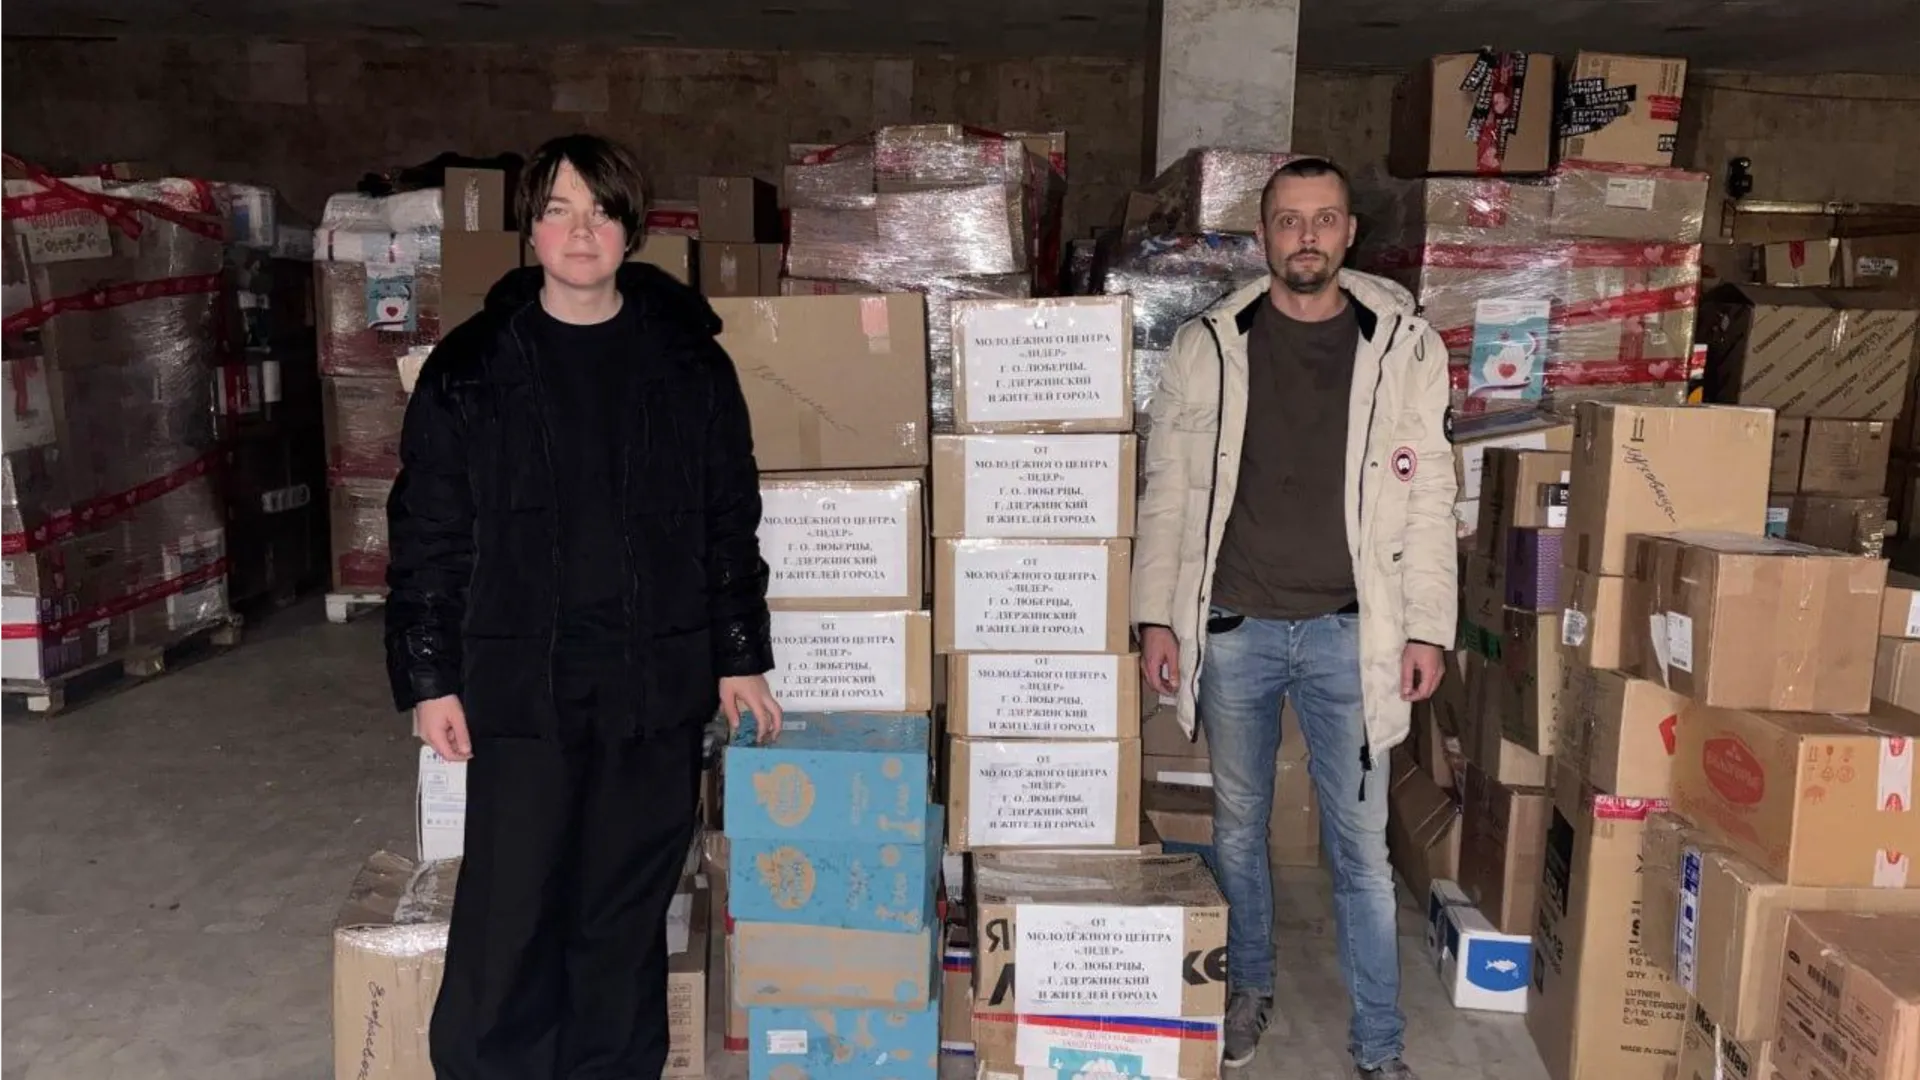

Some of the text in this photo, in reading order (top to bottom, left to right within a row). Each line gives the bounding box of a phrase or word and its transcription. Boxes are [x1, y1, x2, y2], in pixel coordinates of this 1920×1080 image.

[975, 334, 1111, 346] МОЛОДЁЖНОГО ЦЕНТРА
[1008, 377, 1091, 388] ДЗЕРЖИНСКИЙ
[988, 392, 1100, 403] И ЖИТЕЛЕЙ ГОРОДА
[1034, 446, 1048, 454] ОТ
[975, 459, 1108, 469] МОЛОДЁЖНОГО ЦЕНТРА
[823, 502, 837, 511] ОТ
[1007, 500, 1088, 510] ДЗЕРЖИНСКИЙ
[763, 515, 897, 525] МОЛОДЁЖНОГО ЦЕНТРА
[997, 514, 1050, 524] ЖИТЕЛЕЙ
[1054, 516, 1096, 524] ГОРОДА
[796, 556, 877, 565] ДЗЕРЖИНСКИЙ
[787, 569, 840, 580] ЖИТЕЛЕЙ
[843, 571, 885, 580] ГОРОДА
[965, 569, 1097, 581] МОЛОДЁЖНОГО ЦЕНТРА
[998, 611, 1076, 620] ДЗЕРЖИНСКИЙ
[822, 622, 835, 631] ОТ
[987, 625, 1040, 634] ЖИТЕЛЕЙ
[1043, 626, 1084, 634] ГОРОДА
[770, 635, 895, 645] ОЛОДЁЖНОГО ЦЕНТРА
[978, 668, 1107, 680] МОЛОДЁЖНОГО ЦЕНТРА
[796, 675, 876, 684] ДЗЕРЖИНСКИЙ
[776, 688, 883, 698] И ЖИТЕЛЕЙ ГОРОДА
[1008, 708, 1087, 717] ДЗЕРЖИНСКИЙ
[999, 720, 1050, 731] ЖИТЕЛЕЙ
[1053, 723, 1095, 732] ГОРОДА
[1067, 769, 1107, 778] ЦЕНТРА
[999, 820, 1052, 829] ЖИТЕЛЕЙ
[1055, 821, 1095, 829] ГОРОДА
[1091, 917, 1106, 927] ОТ
[1027, 930, 1172, 943] МОЛОДЁЖНОГО ЦЕНТРА
[1061, 975, 1149, 985] ДЗЕРЖИНСКИЙ
[1039, 989, 1158, 1000] И ЖИТЕЛЕЙ ГОРОДА
[1625, 988, 1661, 999] LUTNER
[1620, 1044, 1642, 1053] MADE
